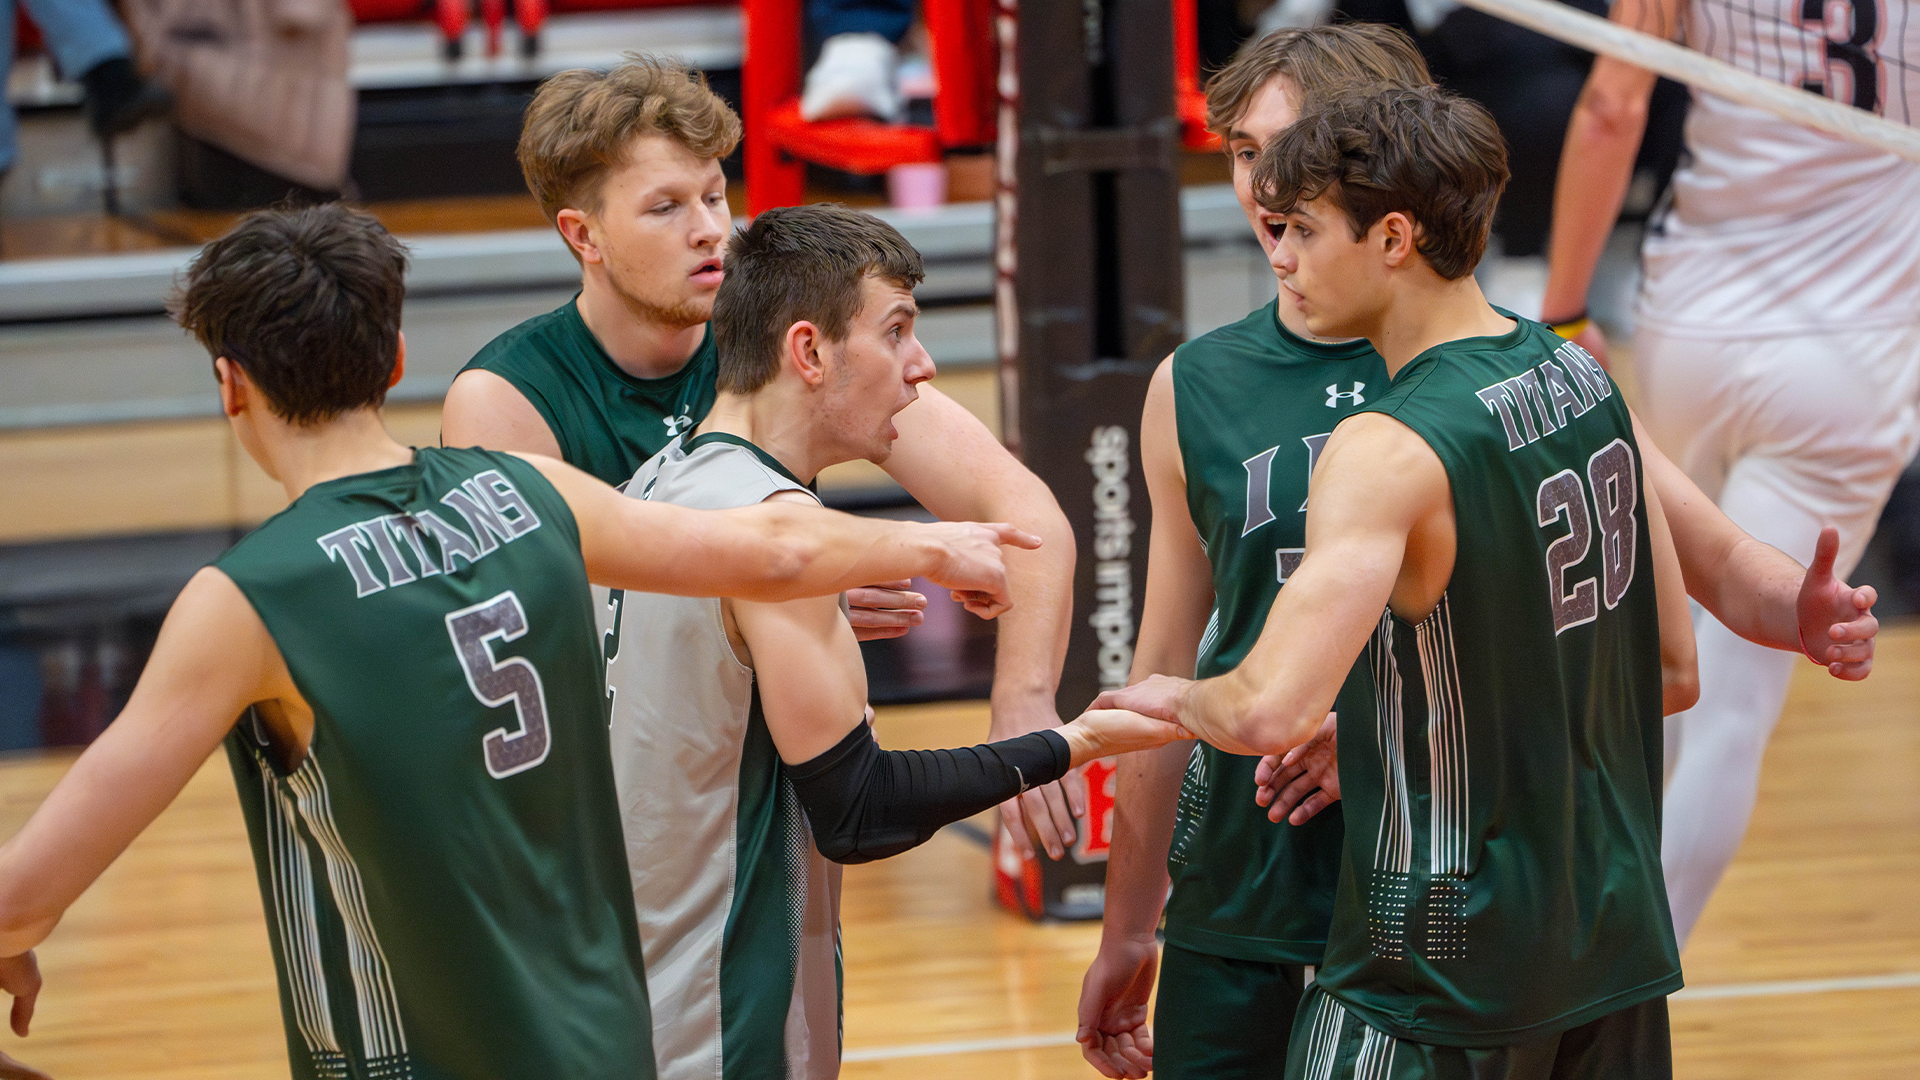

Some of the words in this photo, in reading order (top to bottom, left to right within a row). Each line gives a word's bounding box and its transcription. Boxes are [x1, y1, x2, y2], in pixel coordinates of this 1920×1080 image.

[1475, 340, 1612, 452] TITANS
[316, 469, 542, 598] TITANS
[1084, 425, 1136, 560] sports
[1536, 437, 1637, 637] 28
[445, 590, 551, 779] 5
[1088, 561, 1134, 695] impor
